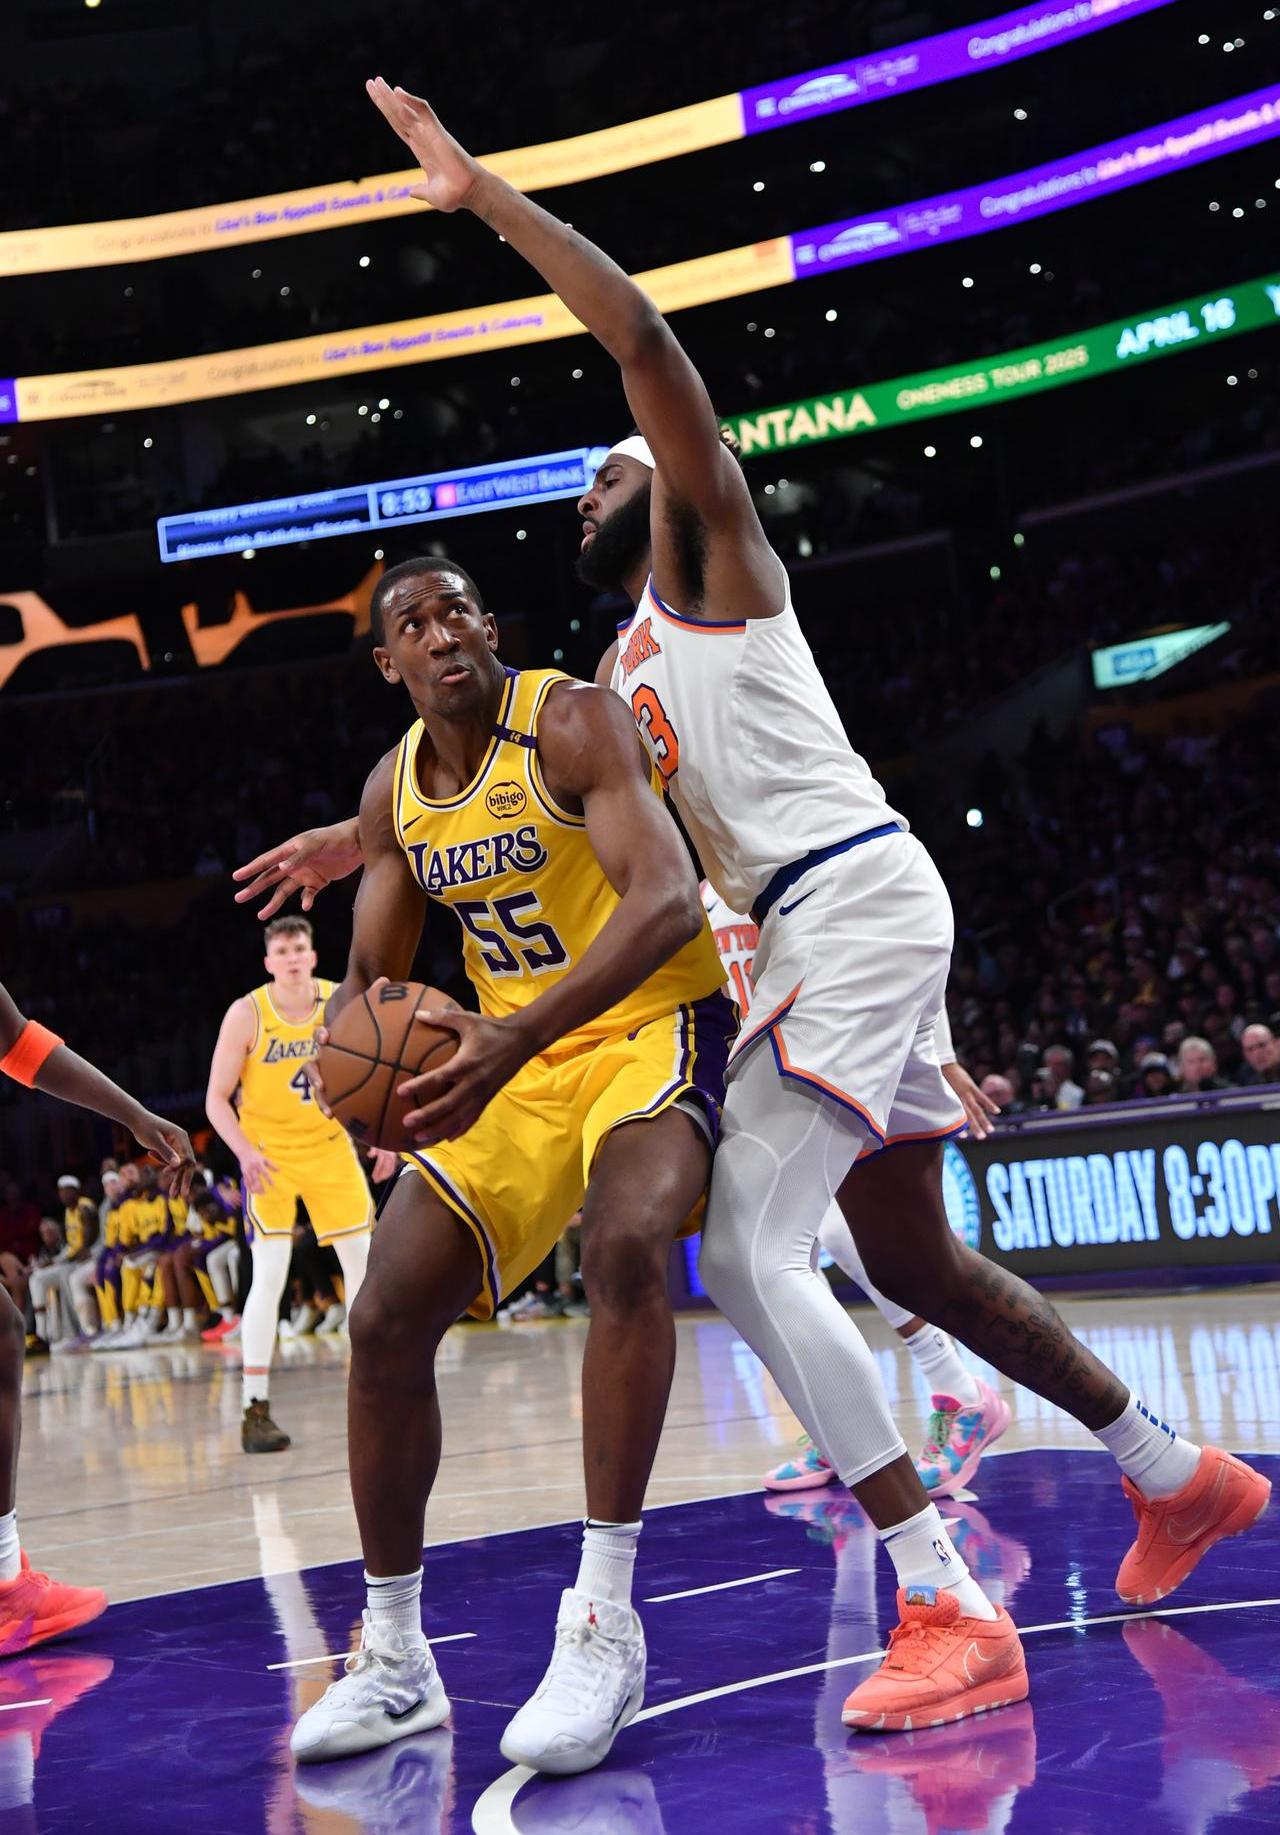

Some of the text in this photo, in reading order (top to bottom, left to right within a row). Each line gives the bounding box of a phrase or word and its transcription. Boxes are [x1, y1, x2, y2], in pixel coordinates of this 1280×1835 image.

[1116, 311, 1199, 359] APRIL
[896, 345, 1089, 410] ONENESS TOUR 2025
[720, 394, 877, 454] ANTANA
[631, 683, 679, 780] 3
[489, 792, 523, 807] bibigo
[407, 824, 548, 896] LAKERS
[452, 889, 571, 978] 55
[263, 1038, 319, 1064] LAKER
[291, 1067, 312, 1102] 4
[986, 1149, 1160, 1251] SATURDAY
[1163, 1138, 1280, 1240] 8:30P
